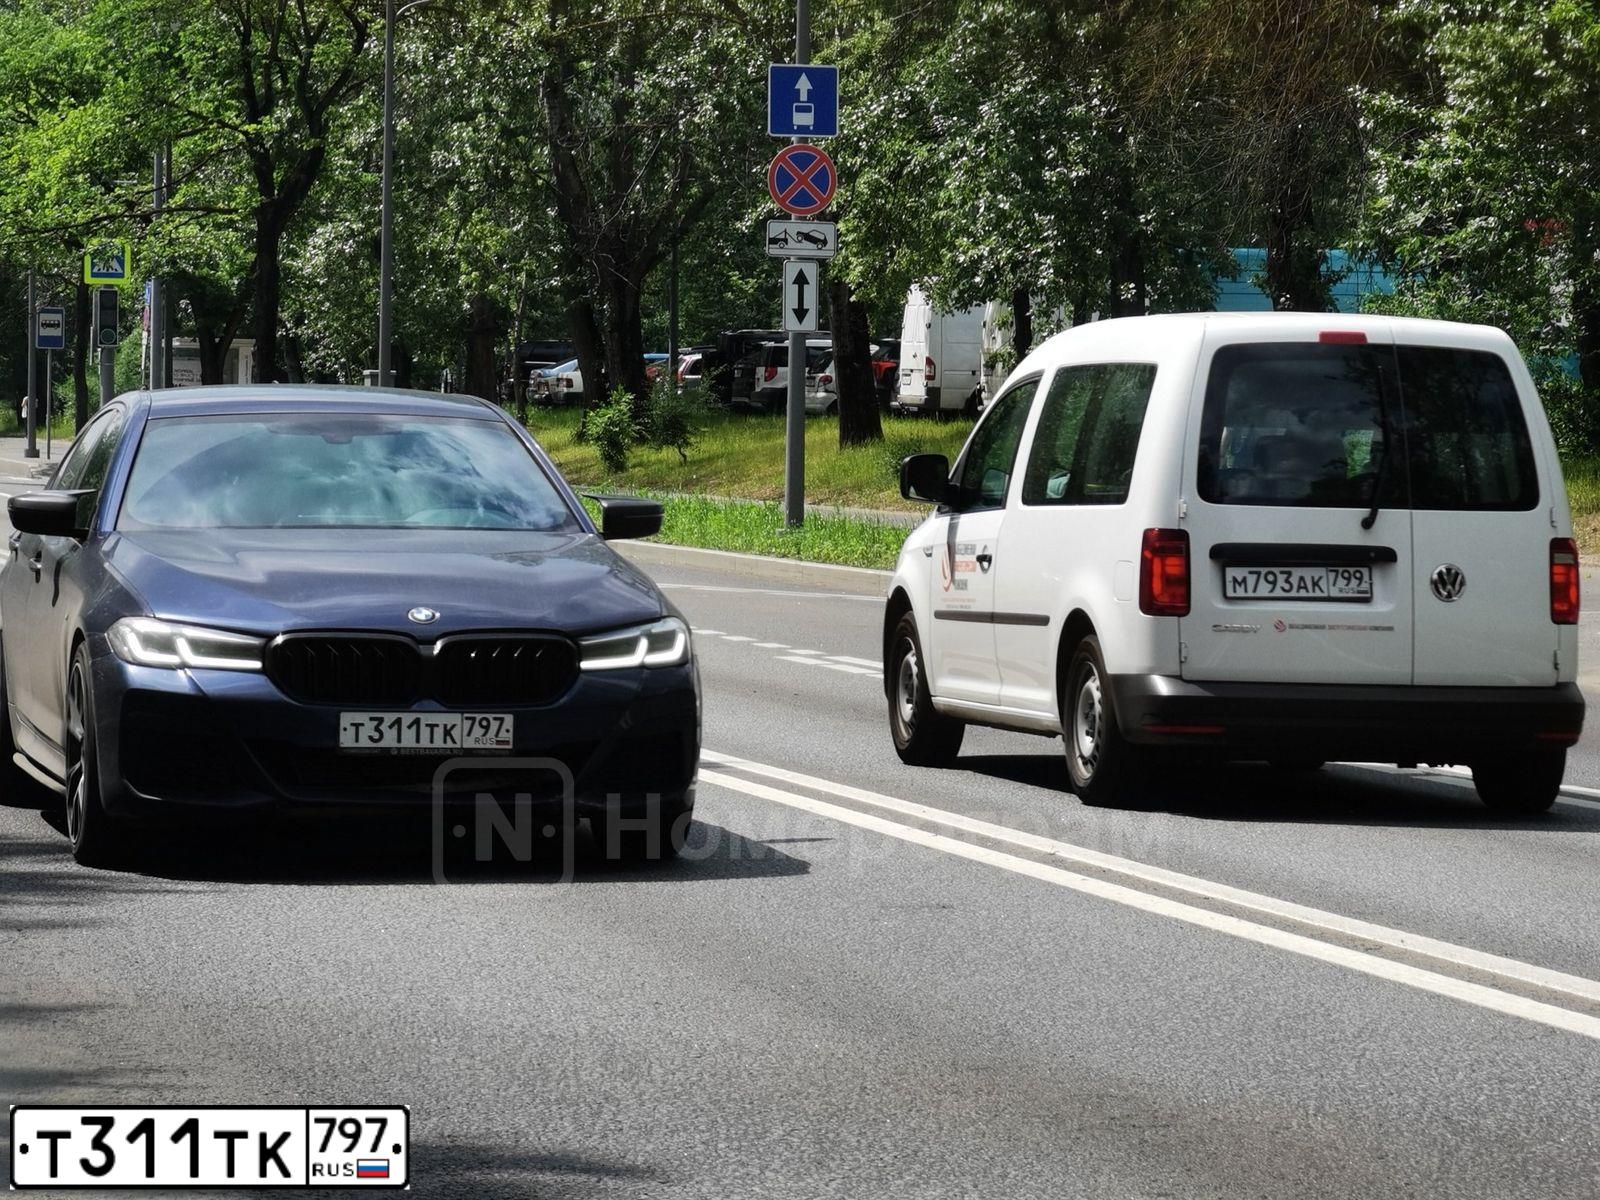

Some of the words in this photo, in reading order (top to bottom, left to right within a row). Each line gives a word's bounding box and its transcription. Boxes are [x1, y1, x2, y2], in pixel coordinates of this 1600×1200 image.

[1232, 570, 1325, 595] М793АК
[1329, 569, 1364, 588] 799
[350, 716, 457, 745] Т311ТК
[464, 716, 505, 738] 797
[474, 737, 495, 746] RUS
